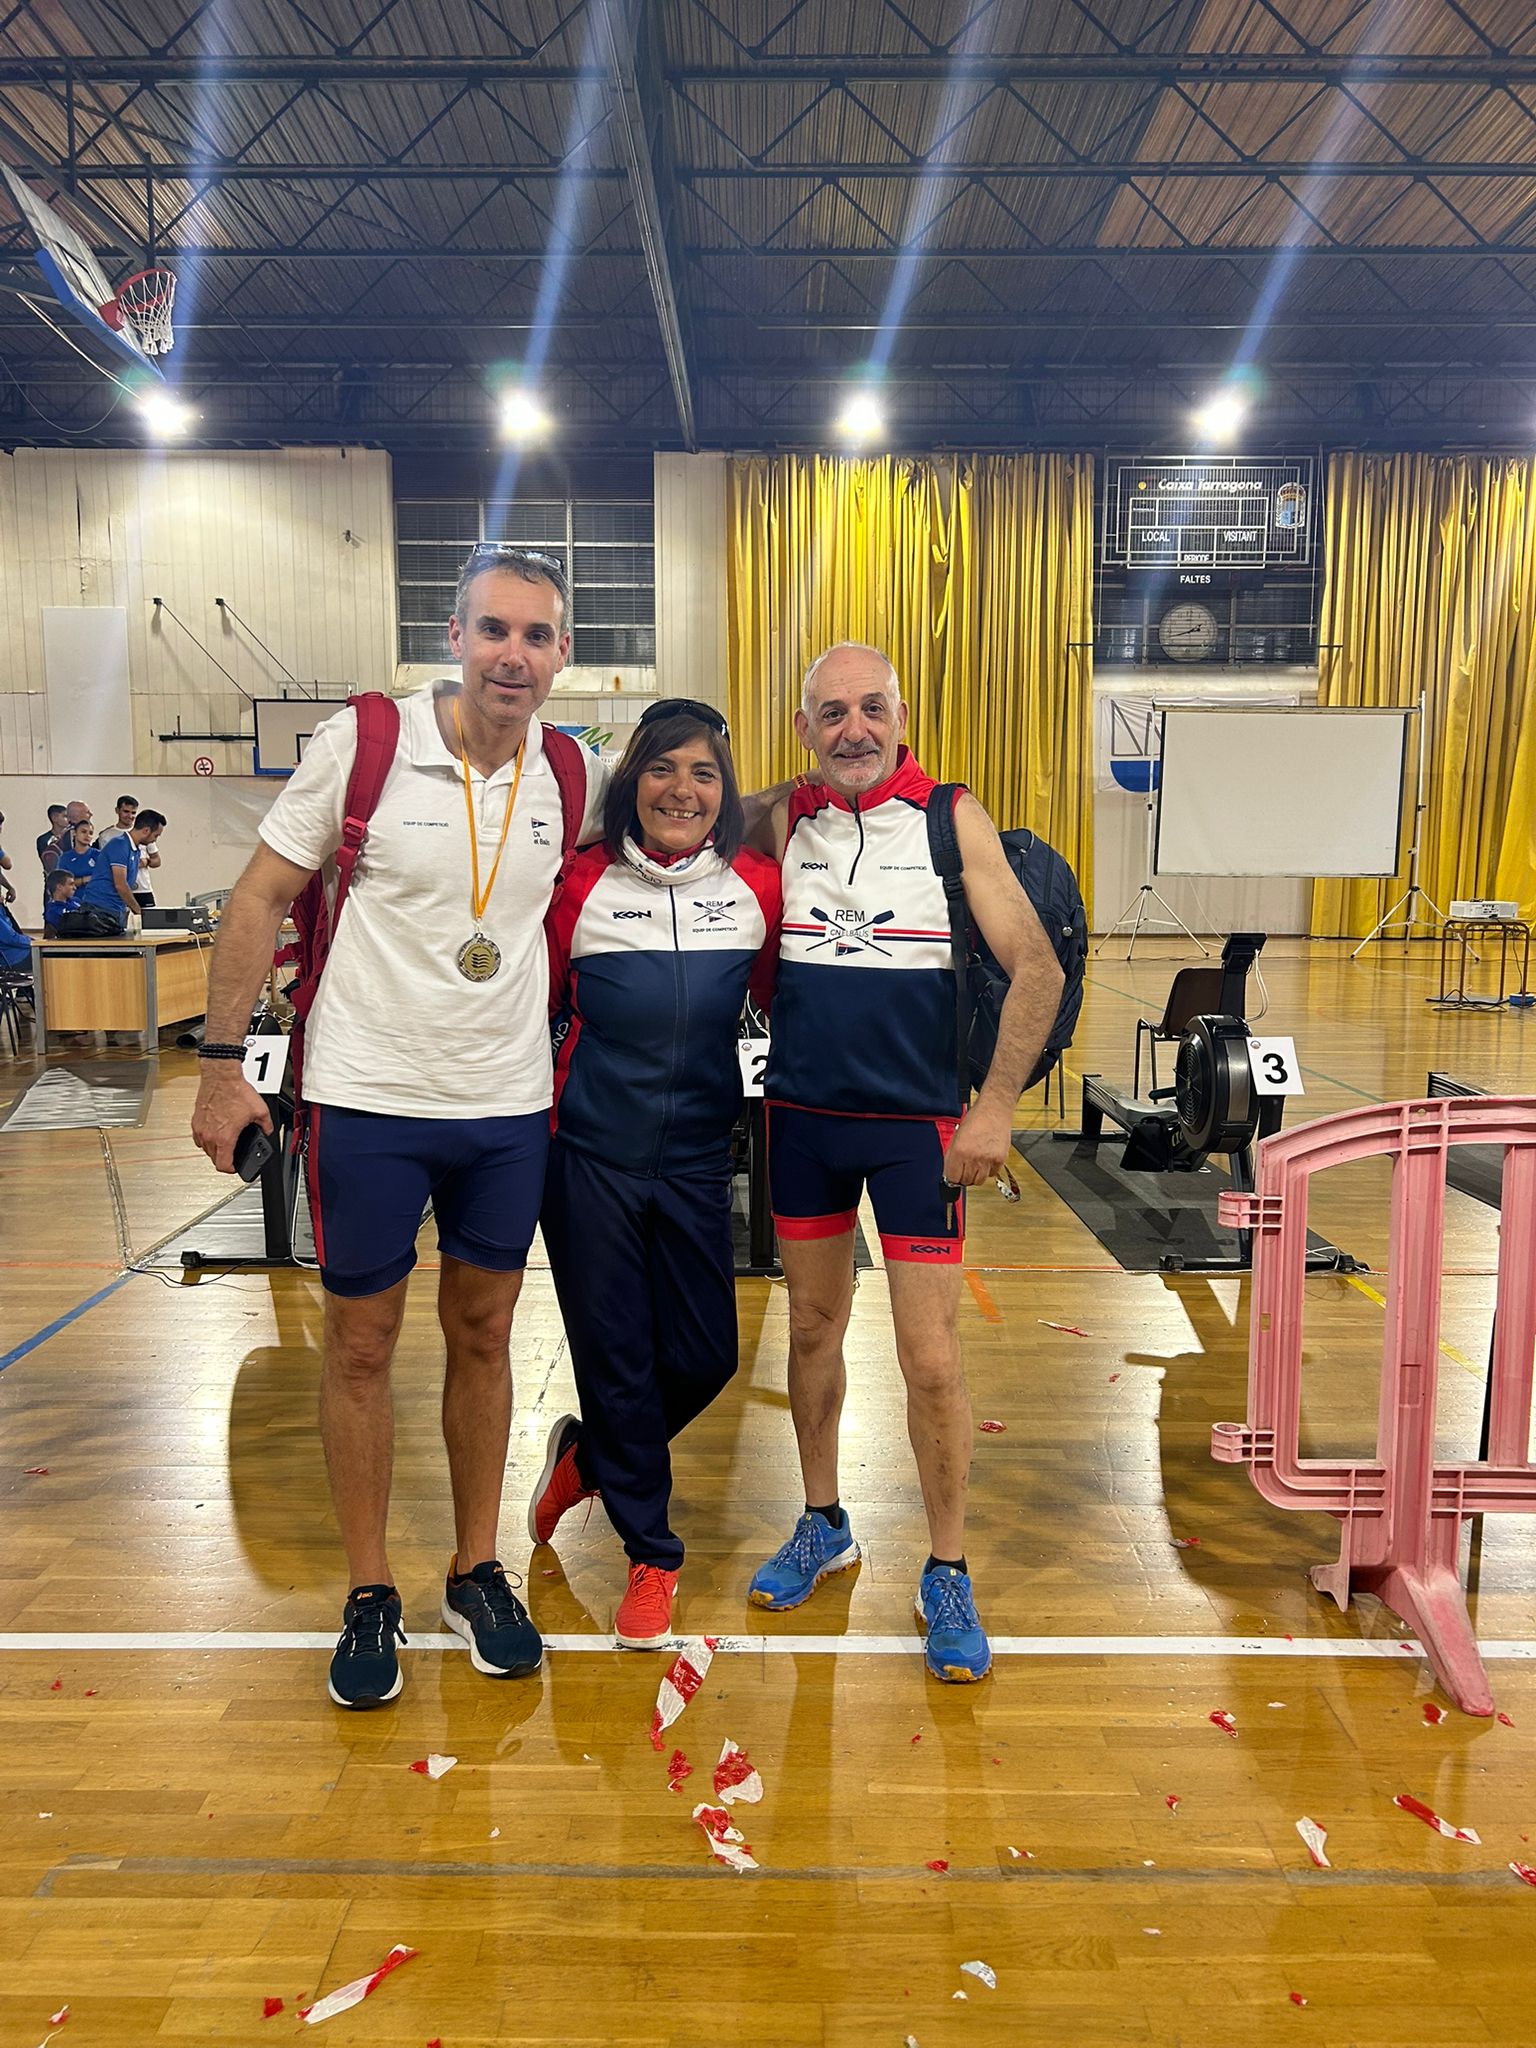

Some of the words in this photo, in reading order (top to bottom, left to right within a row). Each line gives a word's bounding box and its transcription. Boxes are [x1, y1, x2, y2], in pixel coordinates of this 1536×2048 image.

[1158, 479, 1194, 491] Caixa
[1198, 479, 1263, 493] Tarragona
[1141, 531, 1171, 542] LOCAL
[1223, 531, 1258, 542] VISITANT
[1179, 575, 1212, 584] FALTES
[835, 909, 865, 922] REM
[254, 1052, 270, 1081] 1
[751, 1055, 769, 1085] 2
[1262, 1053, 1289, 1084] 3
